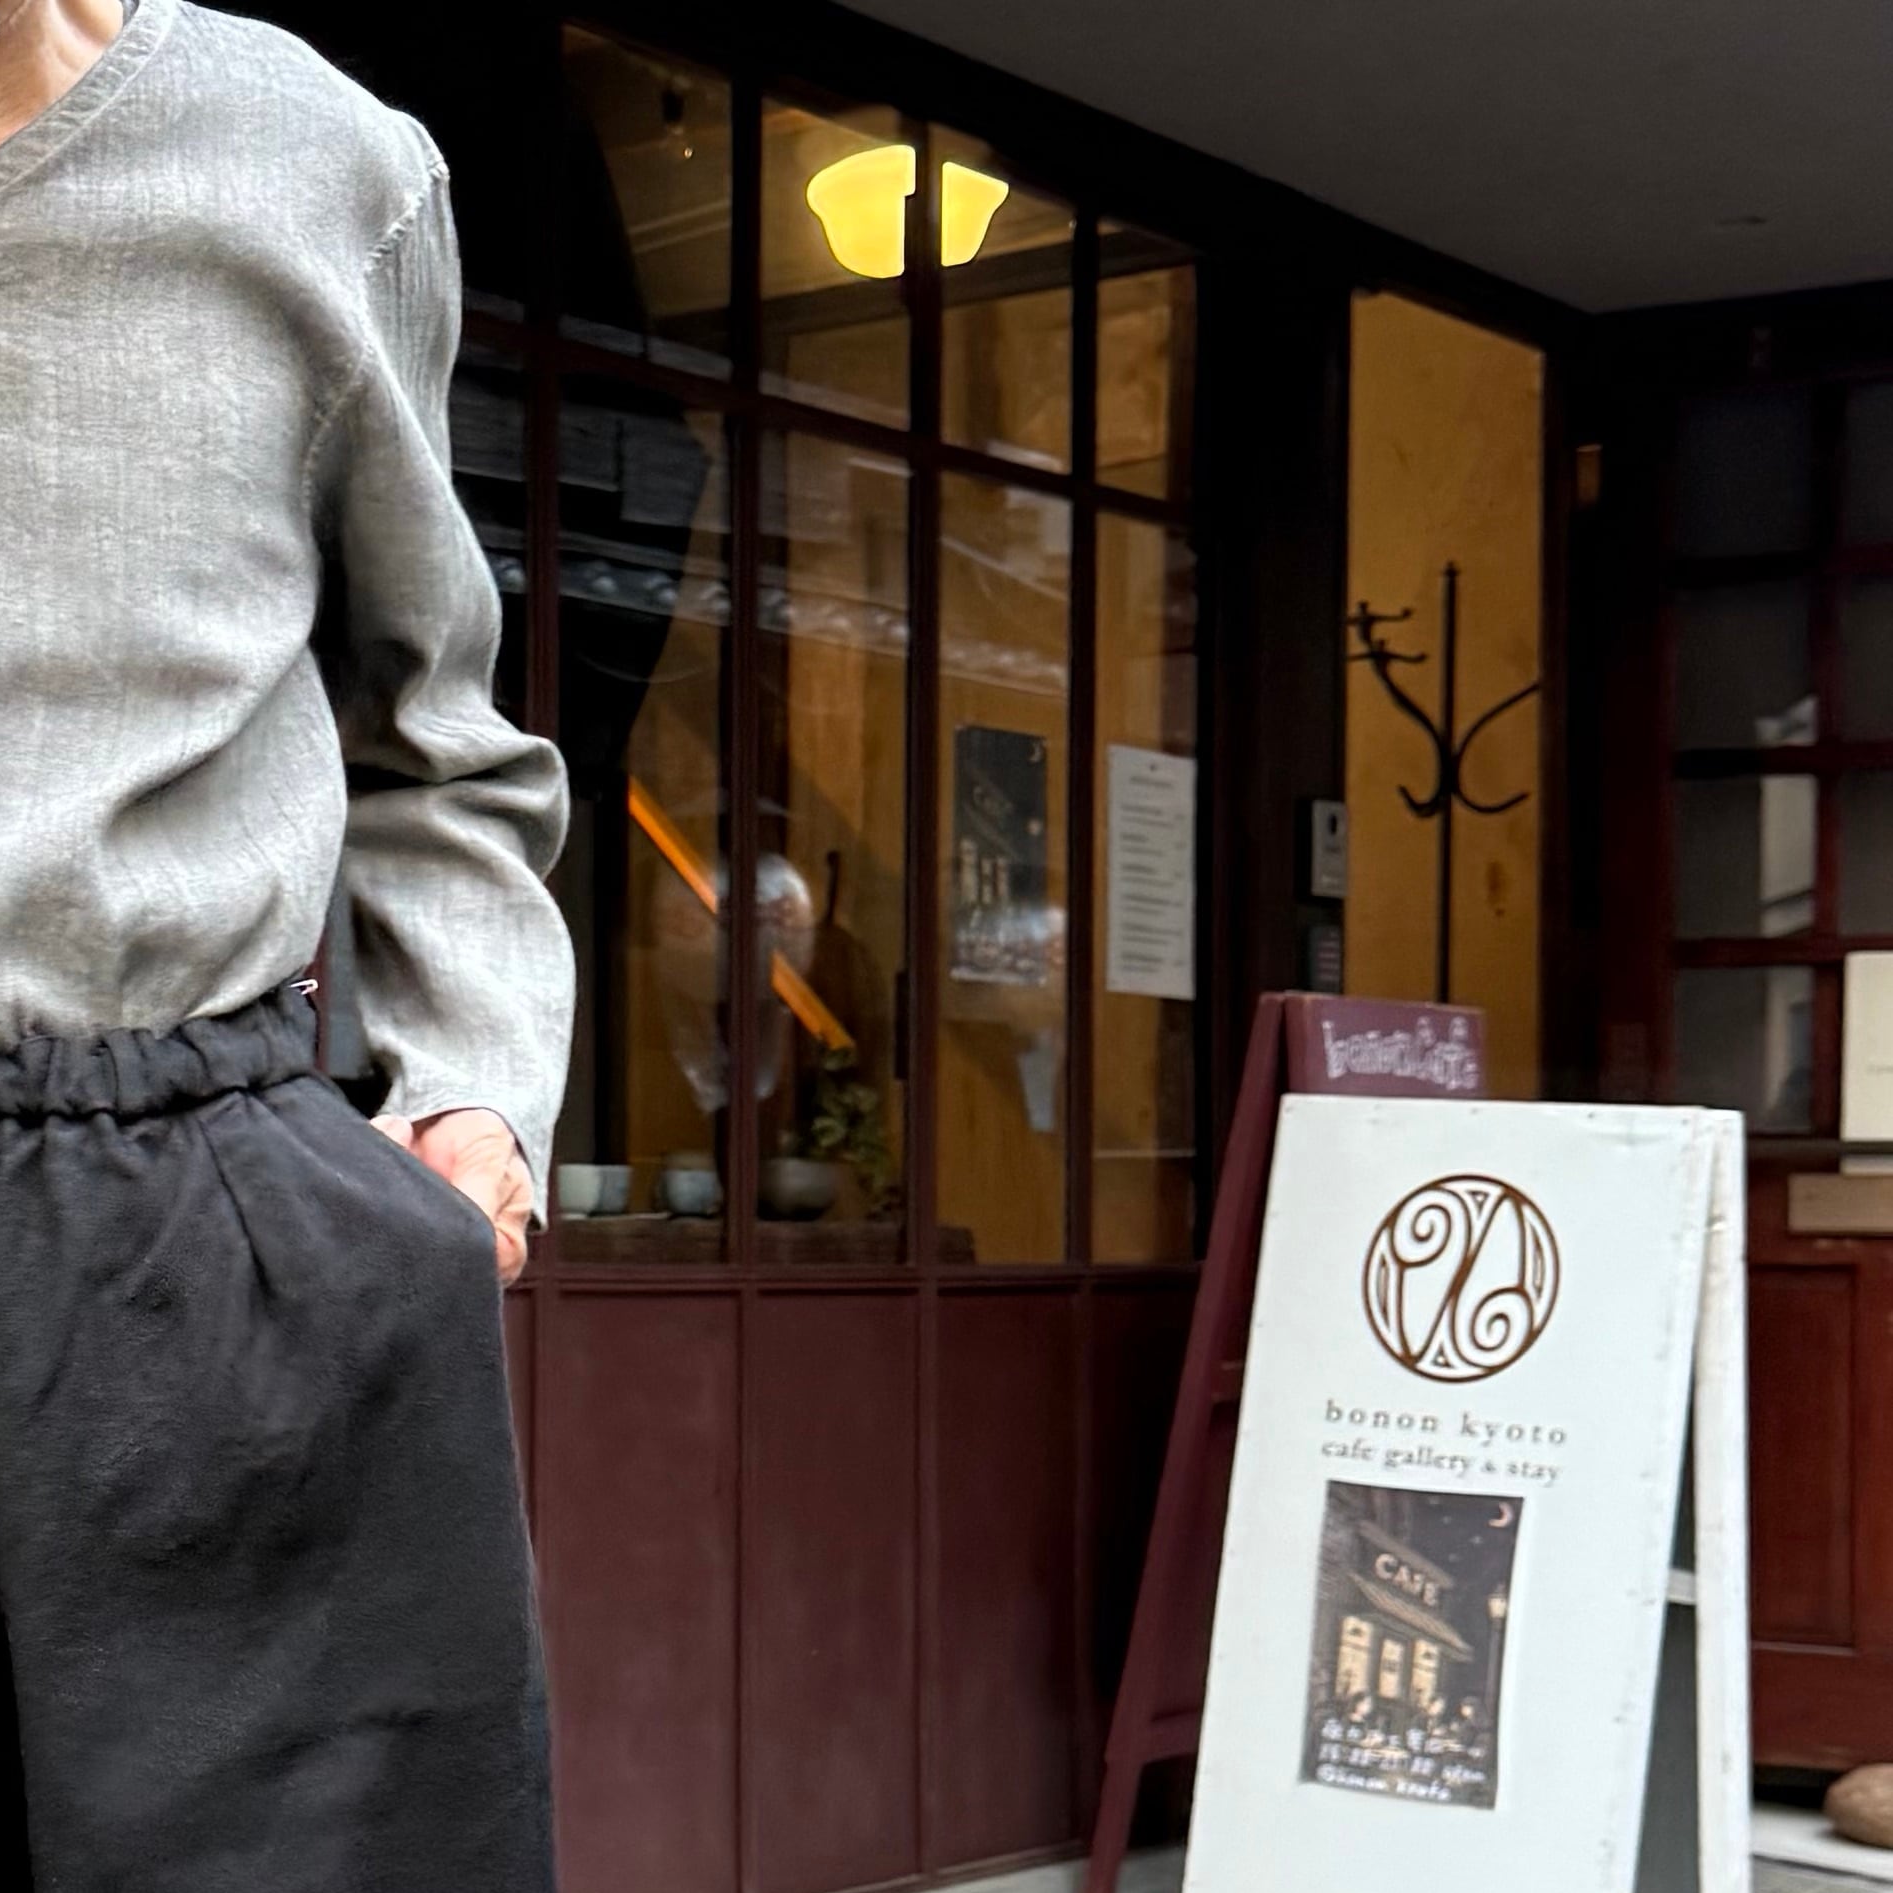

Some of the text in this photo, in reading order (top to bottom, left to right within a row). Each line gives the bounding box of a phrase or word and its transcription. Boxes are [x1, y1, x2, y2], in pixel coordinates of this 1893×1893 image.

[1325, 1400, 1566, 1447] bonon kyoto
[1321, 1438, 1375, 1460] cafe
[1383, 1447, 1471, 1477] gallery
[1507, 1461, 1562, 1489] stay
